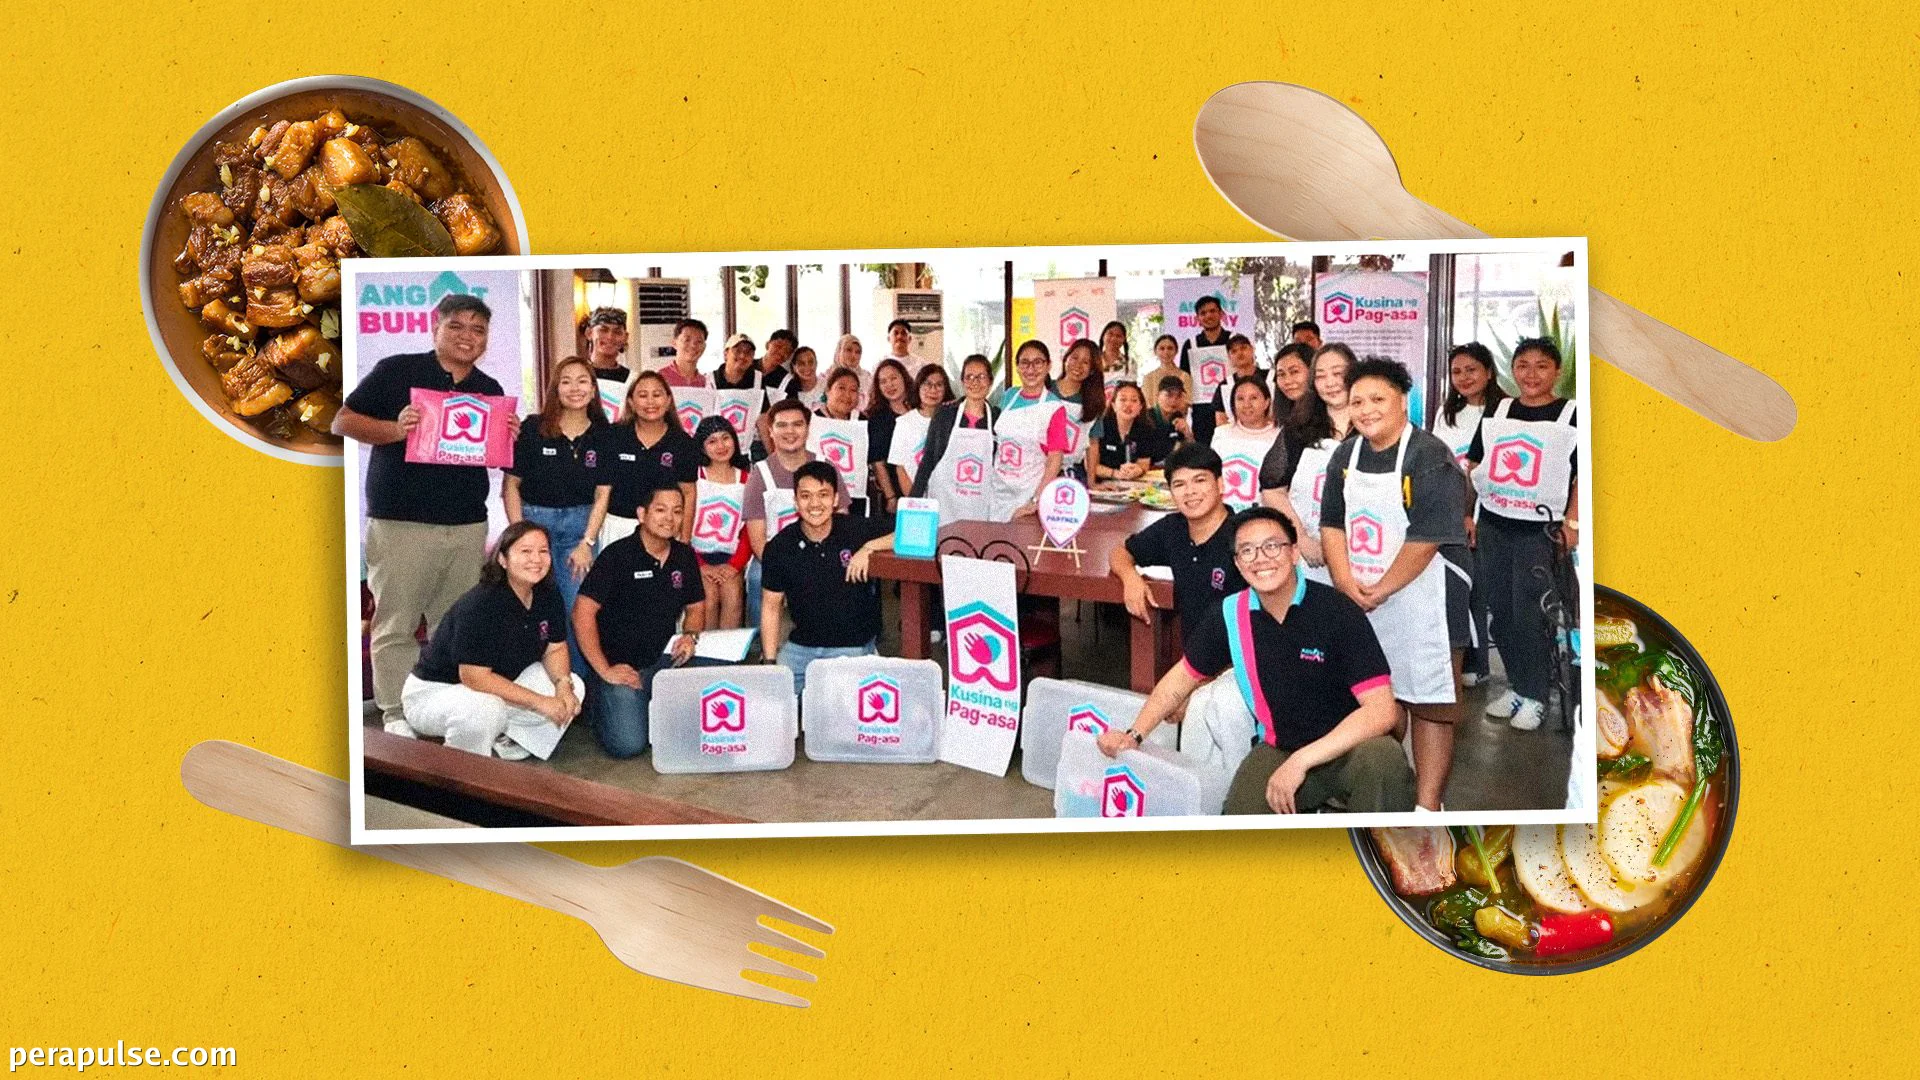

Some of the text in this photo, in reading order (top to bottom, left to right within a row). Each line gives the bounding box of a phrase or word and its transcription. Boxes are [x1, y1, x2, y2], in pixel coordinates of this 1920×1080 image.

[1355, 296, 1403, 308] Kusina
[359, 308, 441, 334] BUH
[1355, 309, 1418, 323] Pag-asa
[950, 684, 1018, 713] Kusina ng
[950, 700, 1017, 731] Pag-asa
[857, 733, 900, 745] Pag-asa
[701, 743, 747, 755] Pag-asa
